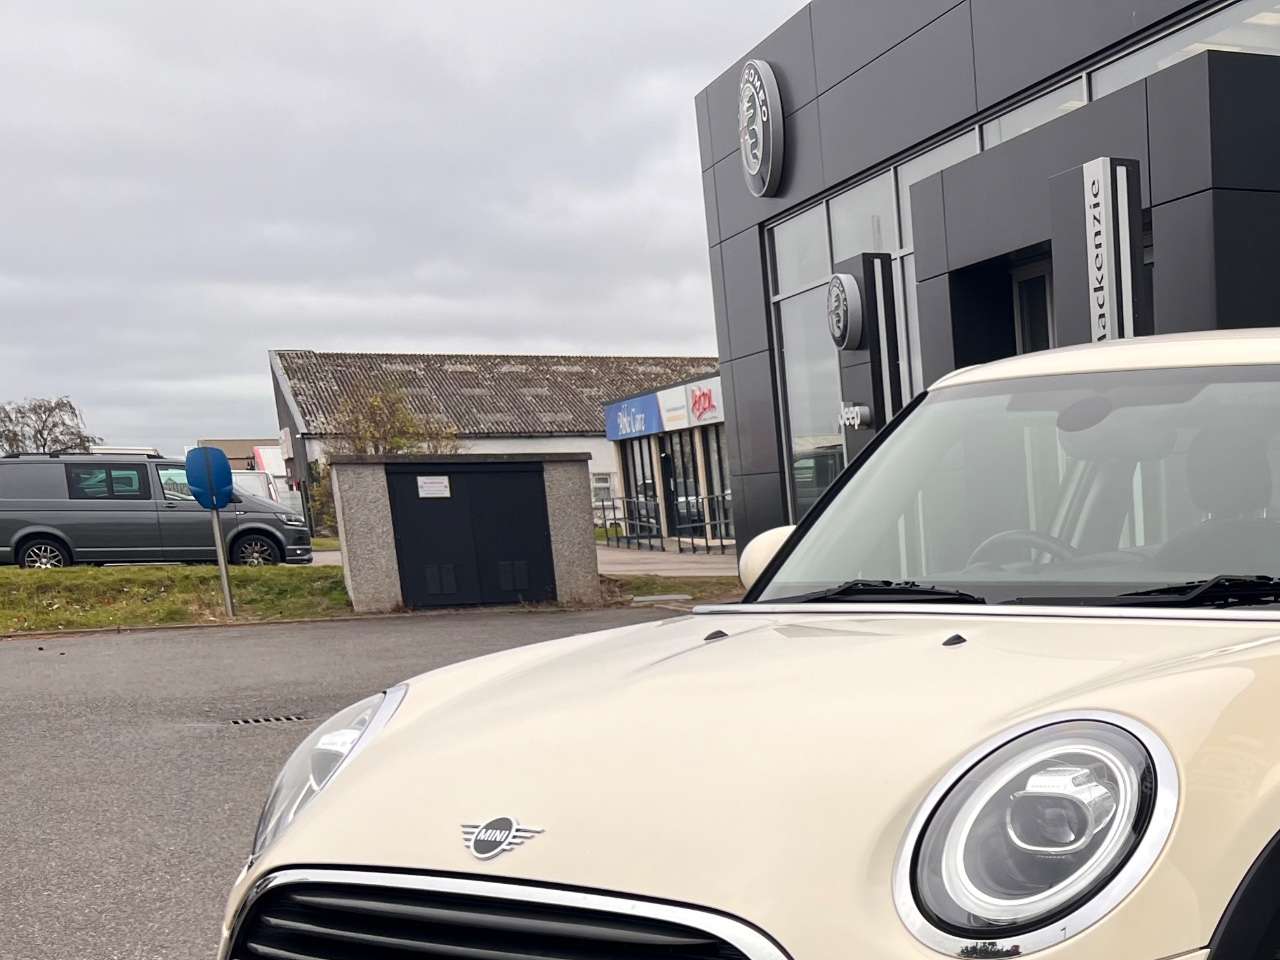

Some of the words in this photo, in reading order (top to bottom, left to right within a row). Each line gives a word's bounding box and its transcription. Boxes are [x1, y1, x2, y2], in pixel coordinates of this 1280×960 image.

[1089, 179, 1107, 341] ackenzie
[838, 401, 861, 430] Jeep
[477, 828, 510, 842] MINI
